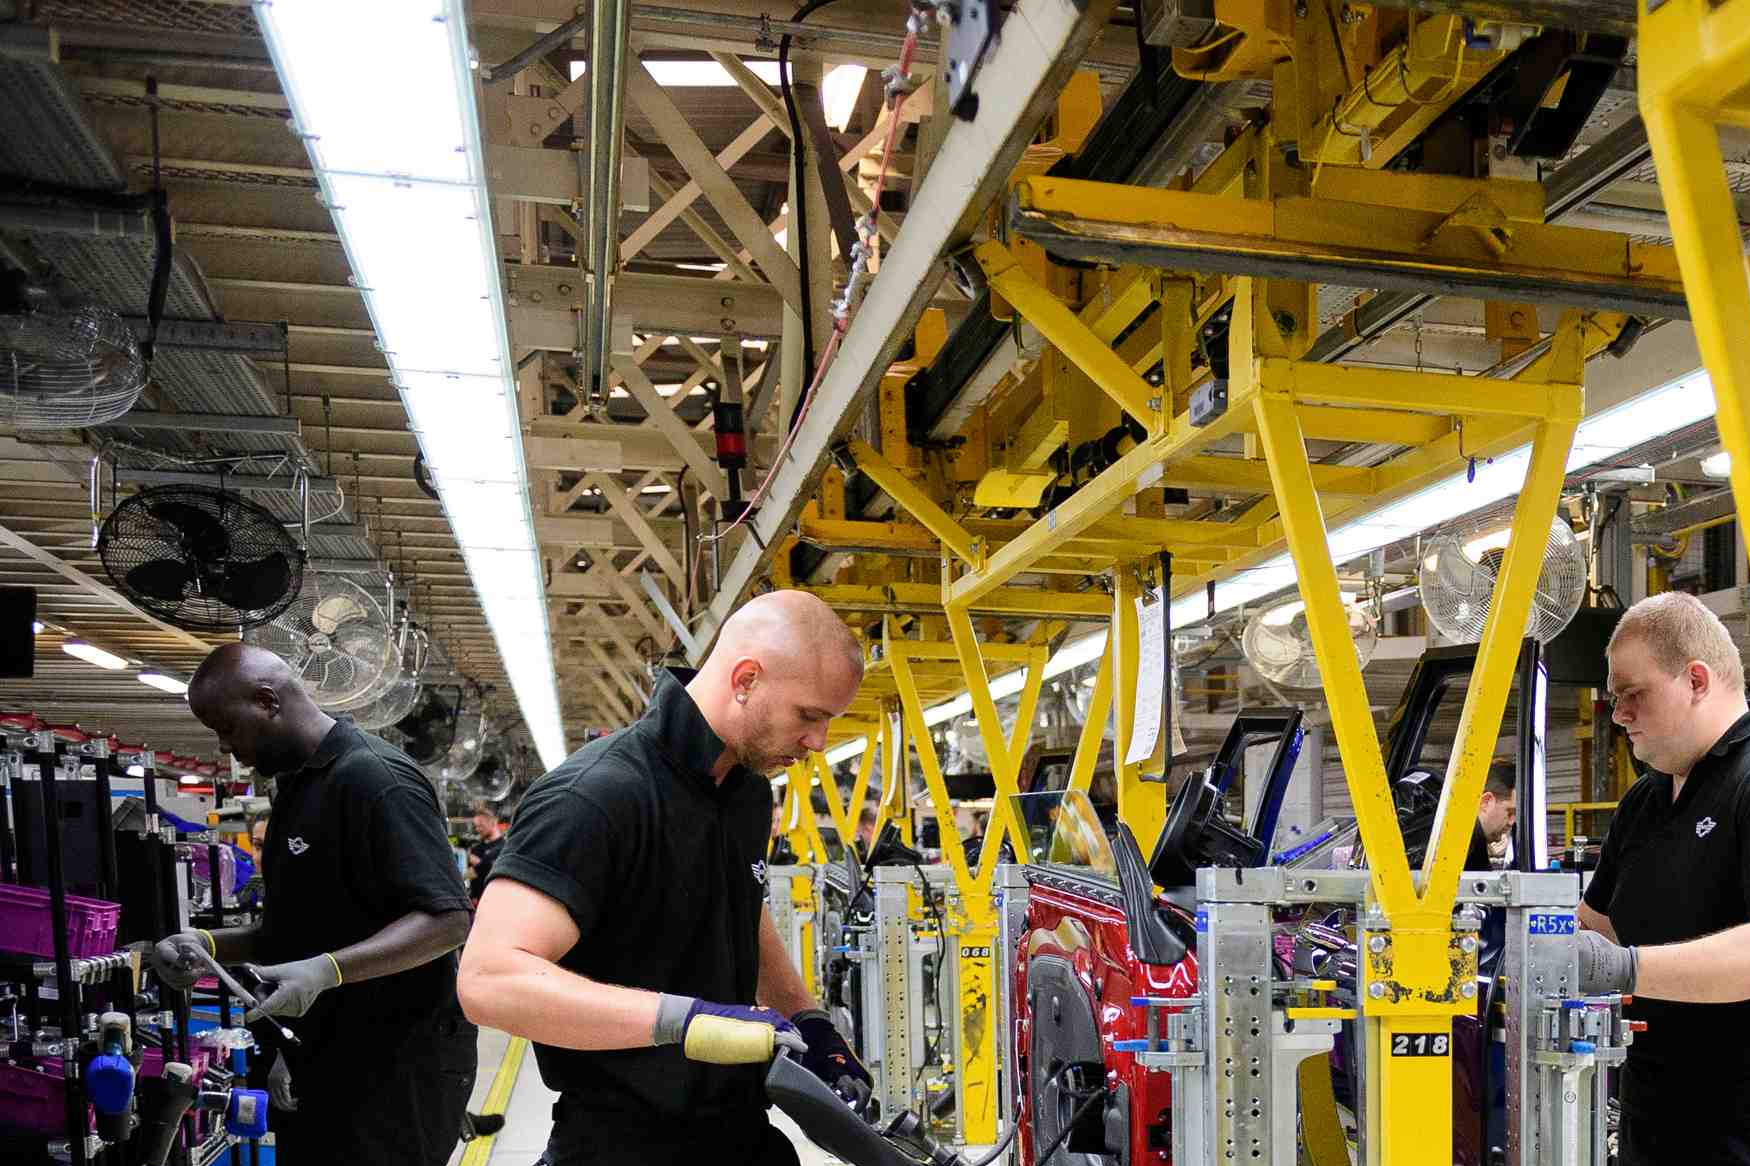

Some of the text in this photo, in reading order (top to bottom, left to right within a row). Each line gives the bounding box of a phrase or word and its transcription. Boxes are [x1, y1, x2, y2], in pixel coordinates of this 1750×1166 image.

[1537, 916, 1568, 933] R5x
[962, 947, 989, 957] 068
[1392, 1035, 1448, 1054] 218
